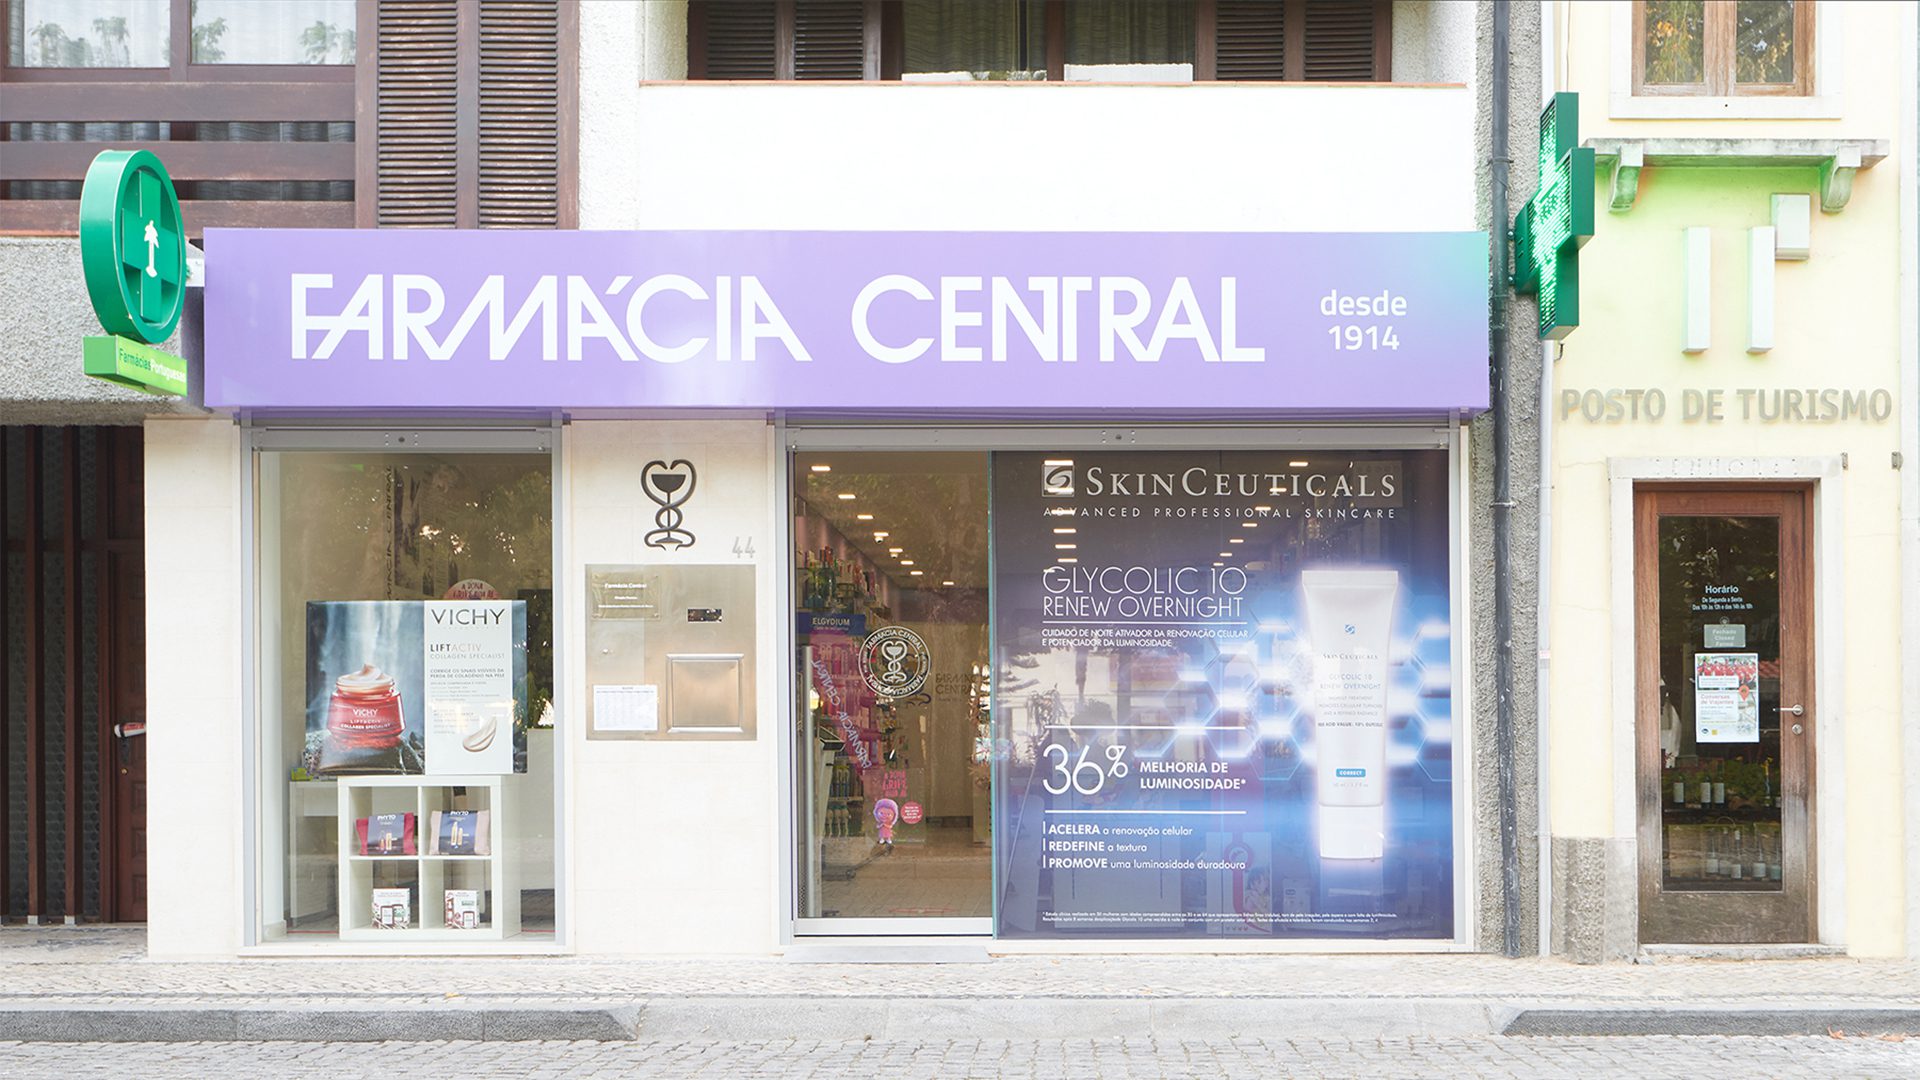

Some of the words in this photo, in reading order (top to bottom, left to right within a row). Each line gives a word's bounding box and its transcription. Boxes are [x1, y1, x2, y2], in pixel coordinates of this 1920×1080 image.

[1320, 290, 1407, 316] desde
[292, 273, 813, 364] FARMÁCIA
[851, 274, 1265, 364] CENTRAL
[1328, 325, 1400, 351] 1914
[120, 347, 151, 372] Farmácias
[1561, 388, 1667, 422] POSTO
[1682, 388, 1724, 422] DE
[1736, 388, 1892, 422] TURISMO
[1086, 466, 1395, 497] SKINCEUTICALS
[1044, 507, 1141, 517] ADVANCED
[1154, 508, 1291, 518] PROFESSIONAL
[1305, 509, 1395, 519] SKINCARE
[732, 536, 756, 559] 44
[1042, 566, 1199, 594] GLYCOLIC
[1211, 567, 1247, 594] 10
[1705, 585, 1739, 594] Horário
[1044, 596, 1111, 617] RENEW
[1118, 596, 1243, 618] OVERNIGHT
[431, 609, 505, 625] VICHY
[813, 617, 850, 626] ELGYDIUM
[1042, 629, 1077, 637] CUIDADO
[1080, 629, 1089, 637] DE
[1091, 629, 1113, 637] NOITE
[1115, 629, 1152, 637] ATIVADOR
[1154, 630, 1165, 638] DA
[1167, 629, 1215, 639] RENOVAÇÃO
[1217, 630, 1249, 638] CELULAR
[430, 644, 482, 653] LIFTACTIV
[1042, 639, 1047, 647] E
[1048, 639, 1102, 647] POTENCIADOR
[1104, 639, 1114, 647] DA
[352, 708, 378, 717] VICHY
[1042, 744, 1129, 795] 36%
[1140, 762, 1208, 773] MELHORIA
[1211, 762, 1228, 773] DE
[1049, 824, 1101, 835] ACELERA
[1112, 826, 1160, 837] renovação
[1162, 827, 1193, 836] celular
[1049, 842, 1105, 852] REDEFINE
[1116, 844, 1148, 852] textura
[1049, 858, 1108, 868] PROMOVE
[1133, 860, 1195, 870] luminosidade
[1197, 860, 1246, 870] duradoura
